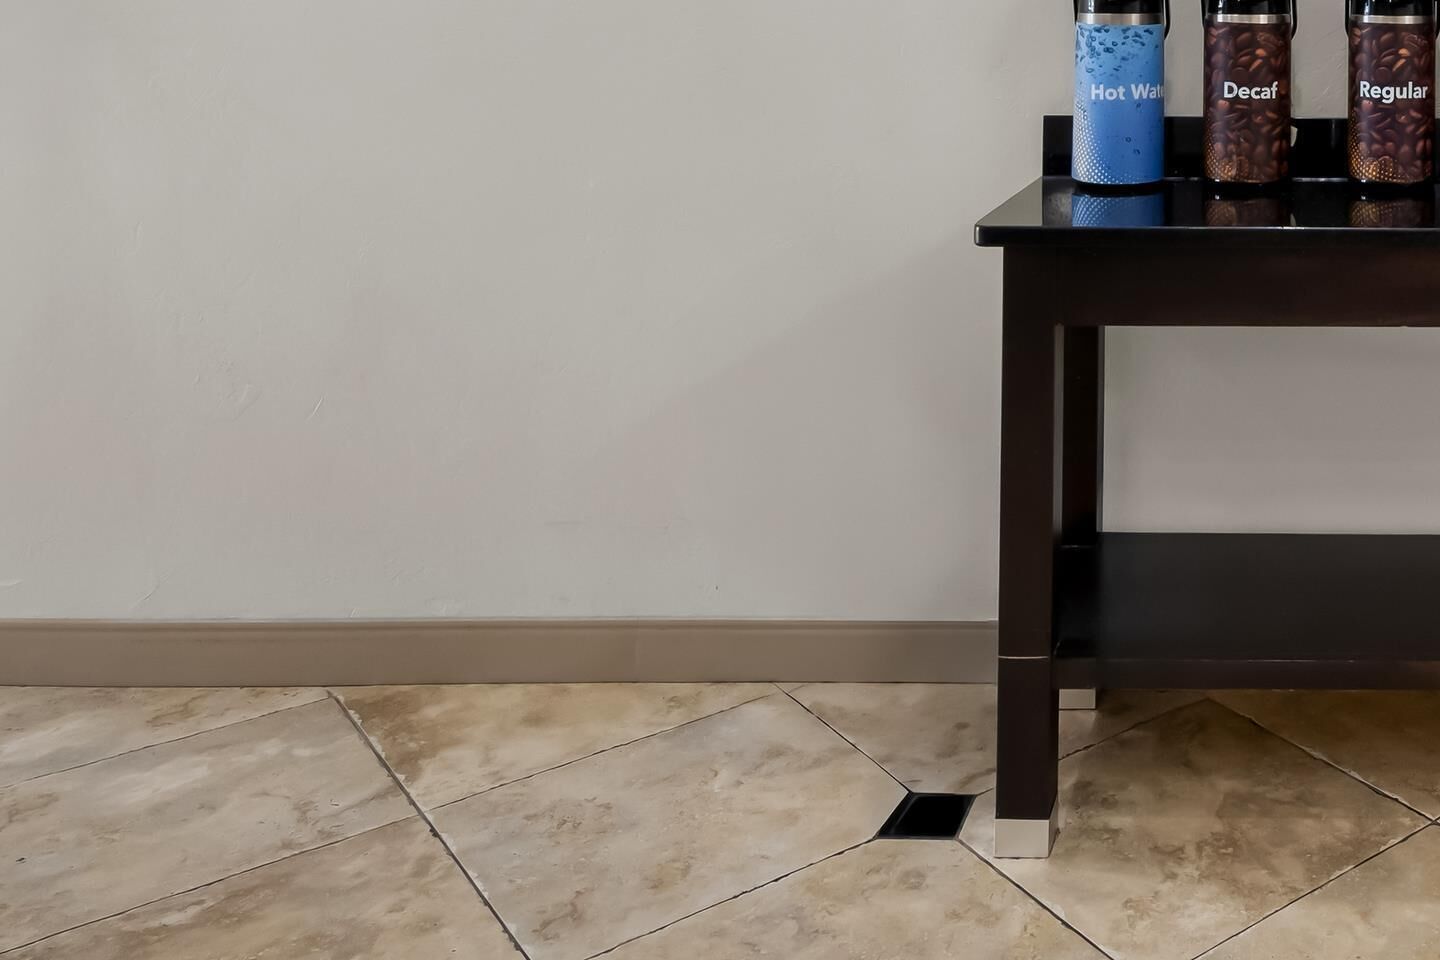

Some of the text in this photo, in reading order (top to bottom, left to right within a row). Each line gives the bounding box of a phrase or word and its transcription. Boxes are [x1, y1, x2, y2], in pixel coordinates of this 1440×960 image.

[1091, 84, 1126, 100] Hot
[1223, 81, 1278, 99] Decaf
[1359, 81, 1428, 104] Regular
